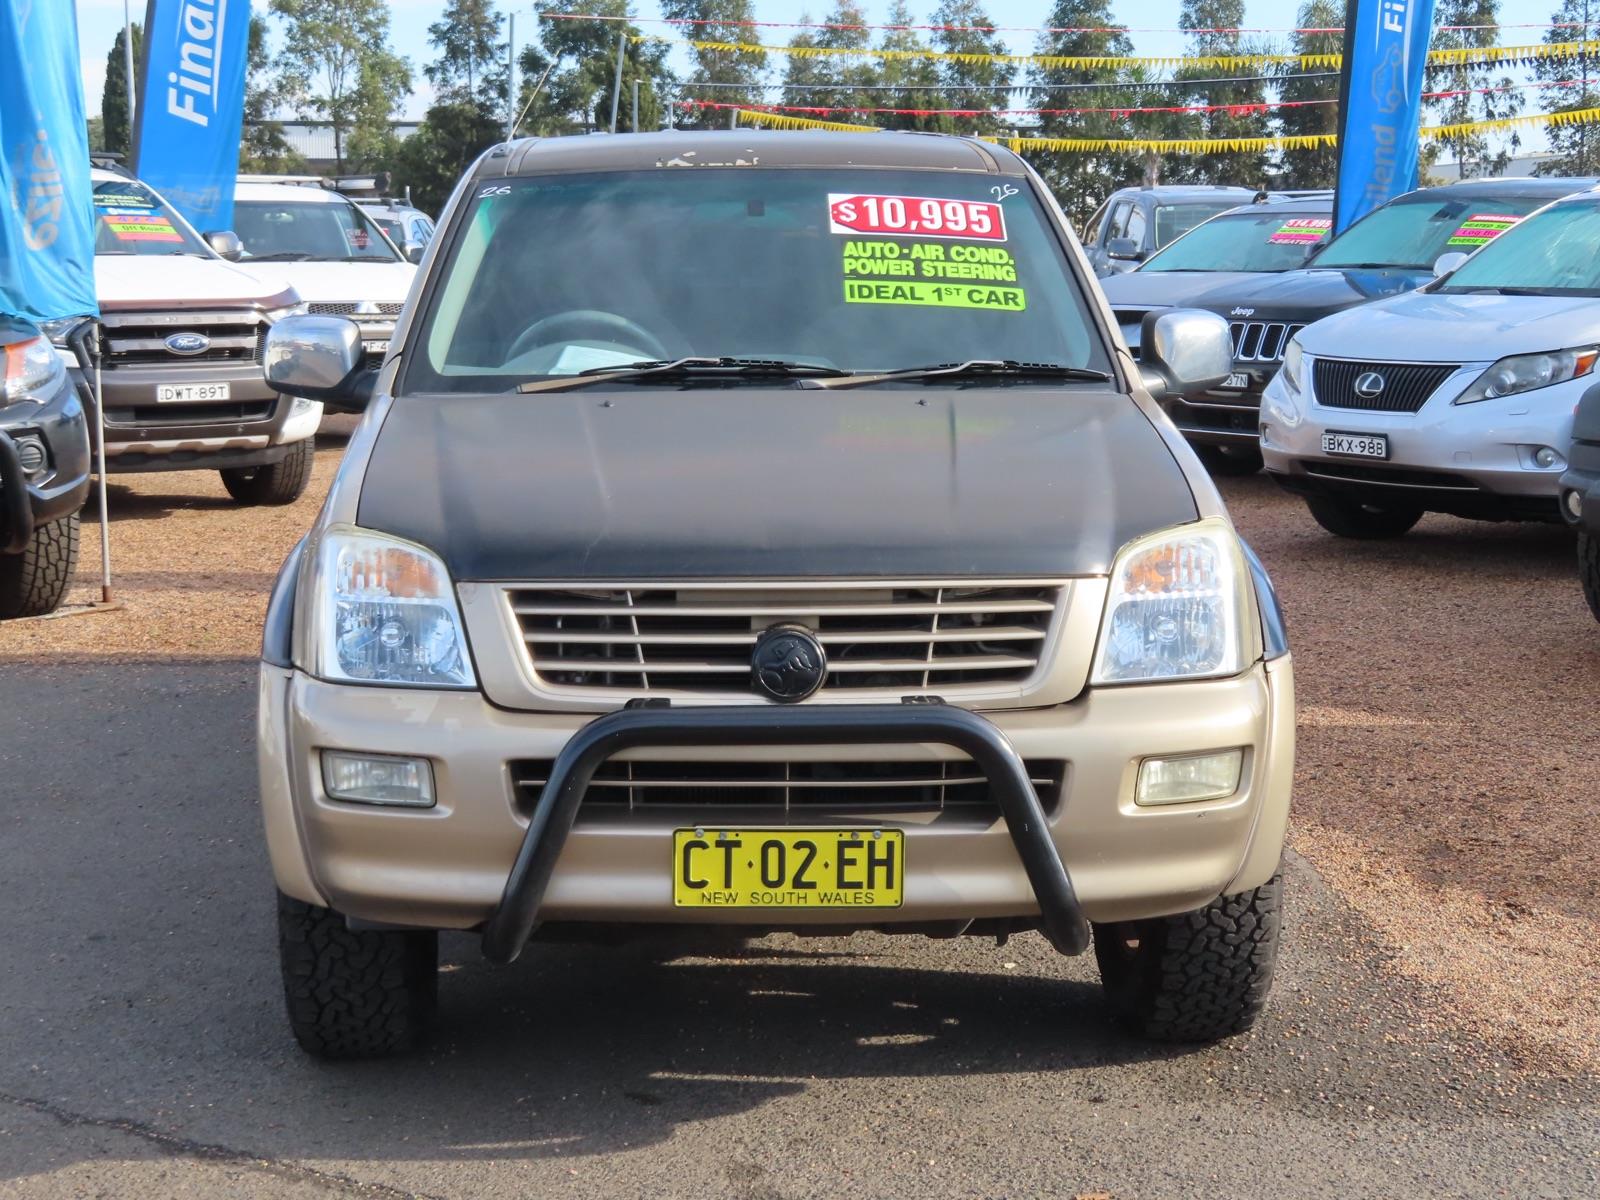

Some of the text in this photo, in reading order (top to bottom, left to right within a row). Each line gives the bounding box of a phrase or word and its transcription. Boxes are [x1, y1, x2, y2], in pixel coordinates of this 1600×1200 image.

[167, 0, 214, 127] Fina
[478, 185, 511, 199] 26
[843, 241, 1015, 265] AUTO-AIR COND.
[844, 258, 1017, 282] POWER STEERING
[848, 284, 925, 302] IDEAL
[967, 288, 1022, 307] CAR
[1231, 306, 1255, 317] Jeep
[701, 891, 876, 906] NEW SOUTH WALES
